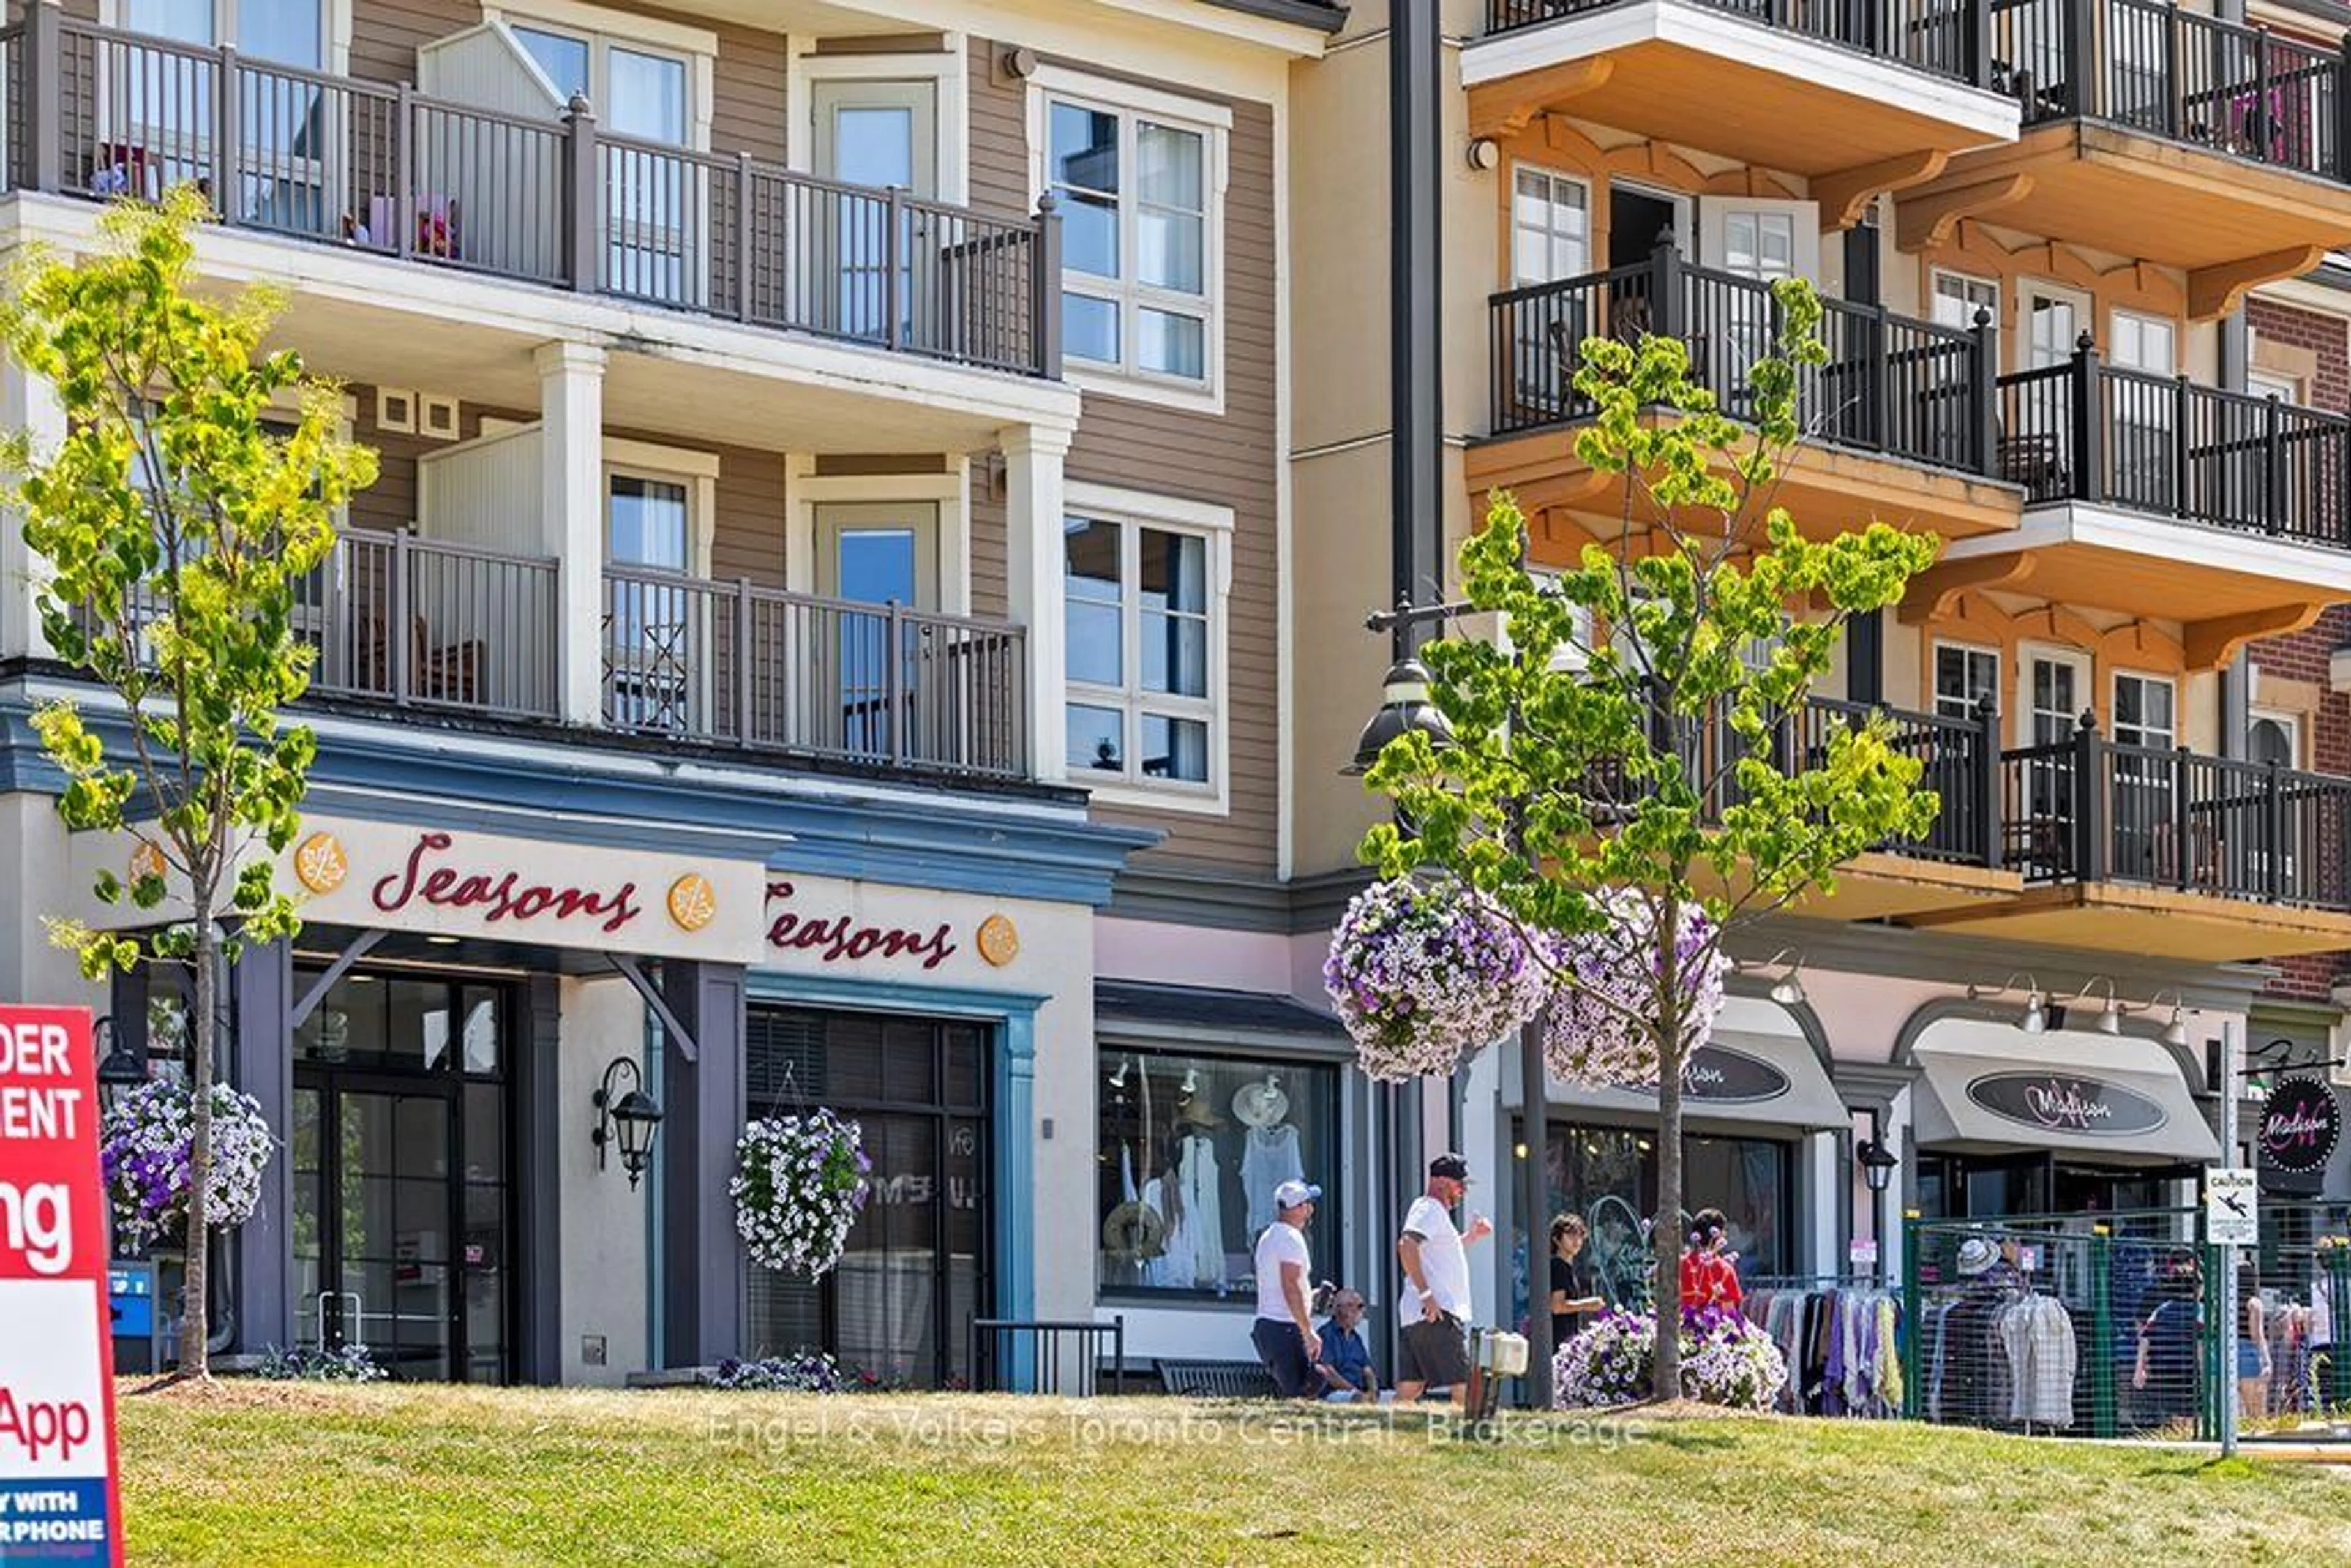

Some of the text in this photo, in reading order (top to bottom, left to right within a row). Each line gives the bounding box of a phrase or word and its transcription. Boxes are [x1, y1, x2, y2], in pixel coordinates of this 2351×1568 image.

[372, 833, 641, 932] Seasons
[0, 1086, 81, 1139] ENT
[2211, 1177, 2253, 1187] CAUTION
[0, 1387, 89, 1461] App
[13, 1490, 78, 1512] WITH
[13, 1520, 105, 1542] PHONE
